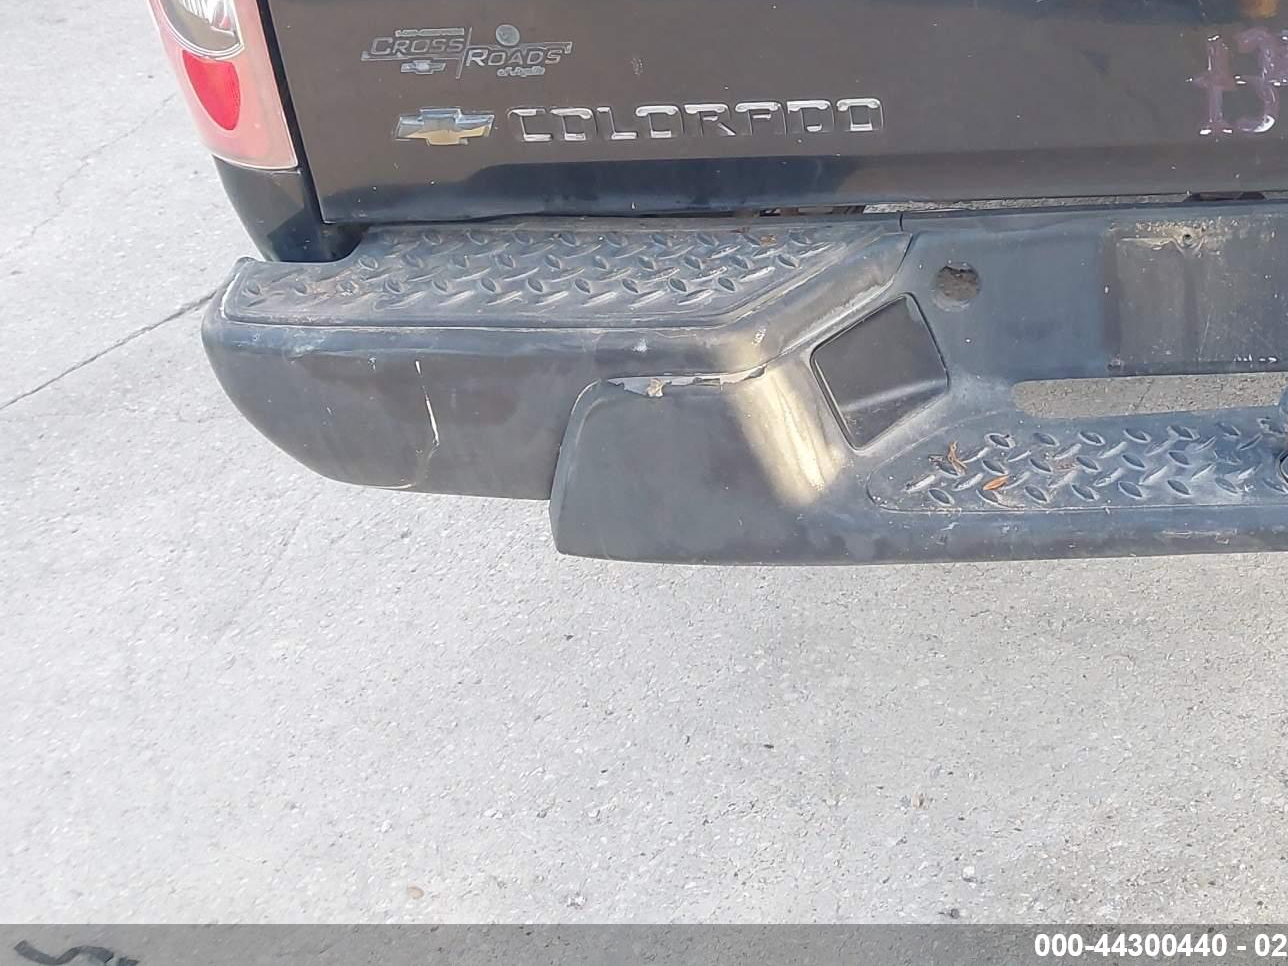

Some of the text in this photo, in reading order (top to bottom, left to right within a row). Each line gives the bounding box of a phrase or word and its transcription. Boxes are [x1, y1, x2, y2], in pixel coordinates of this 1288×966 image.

[369, 37, 464, 55] CROSS
[465, 48, 561, 67] ROADS
[507, 98, 883, 141] COLORADO
